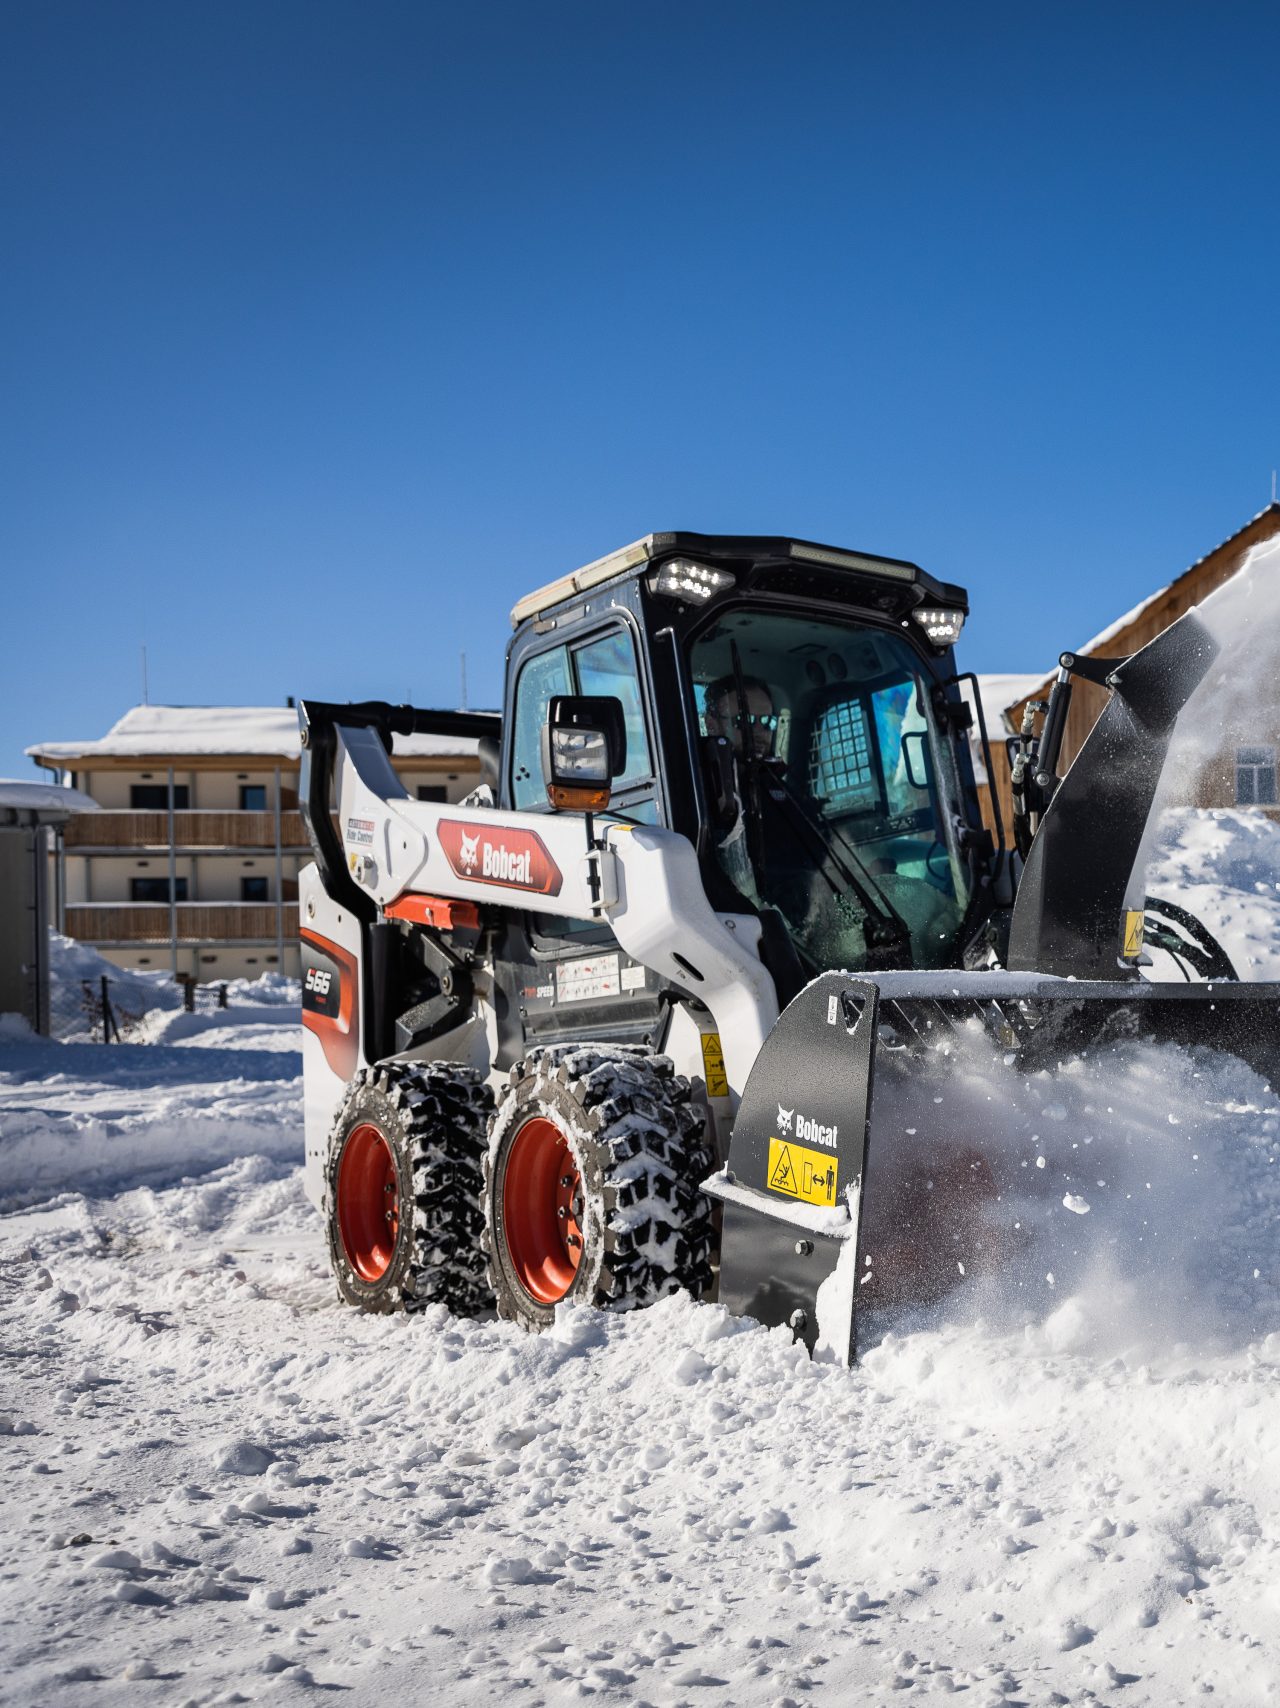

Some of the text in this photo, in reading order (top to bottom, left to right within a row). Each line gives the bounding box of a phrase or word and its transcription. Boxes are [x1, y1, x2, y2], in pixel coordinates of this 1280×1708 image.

[482, 842, 531, 883] Bobcat
[305, 968, 331, 994] S66
[537, 986, 554, 998] SPEED
[796, 1114, 838, 1148] Bobcat
